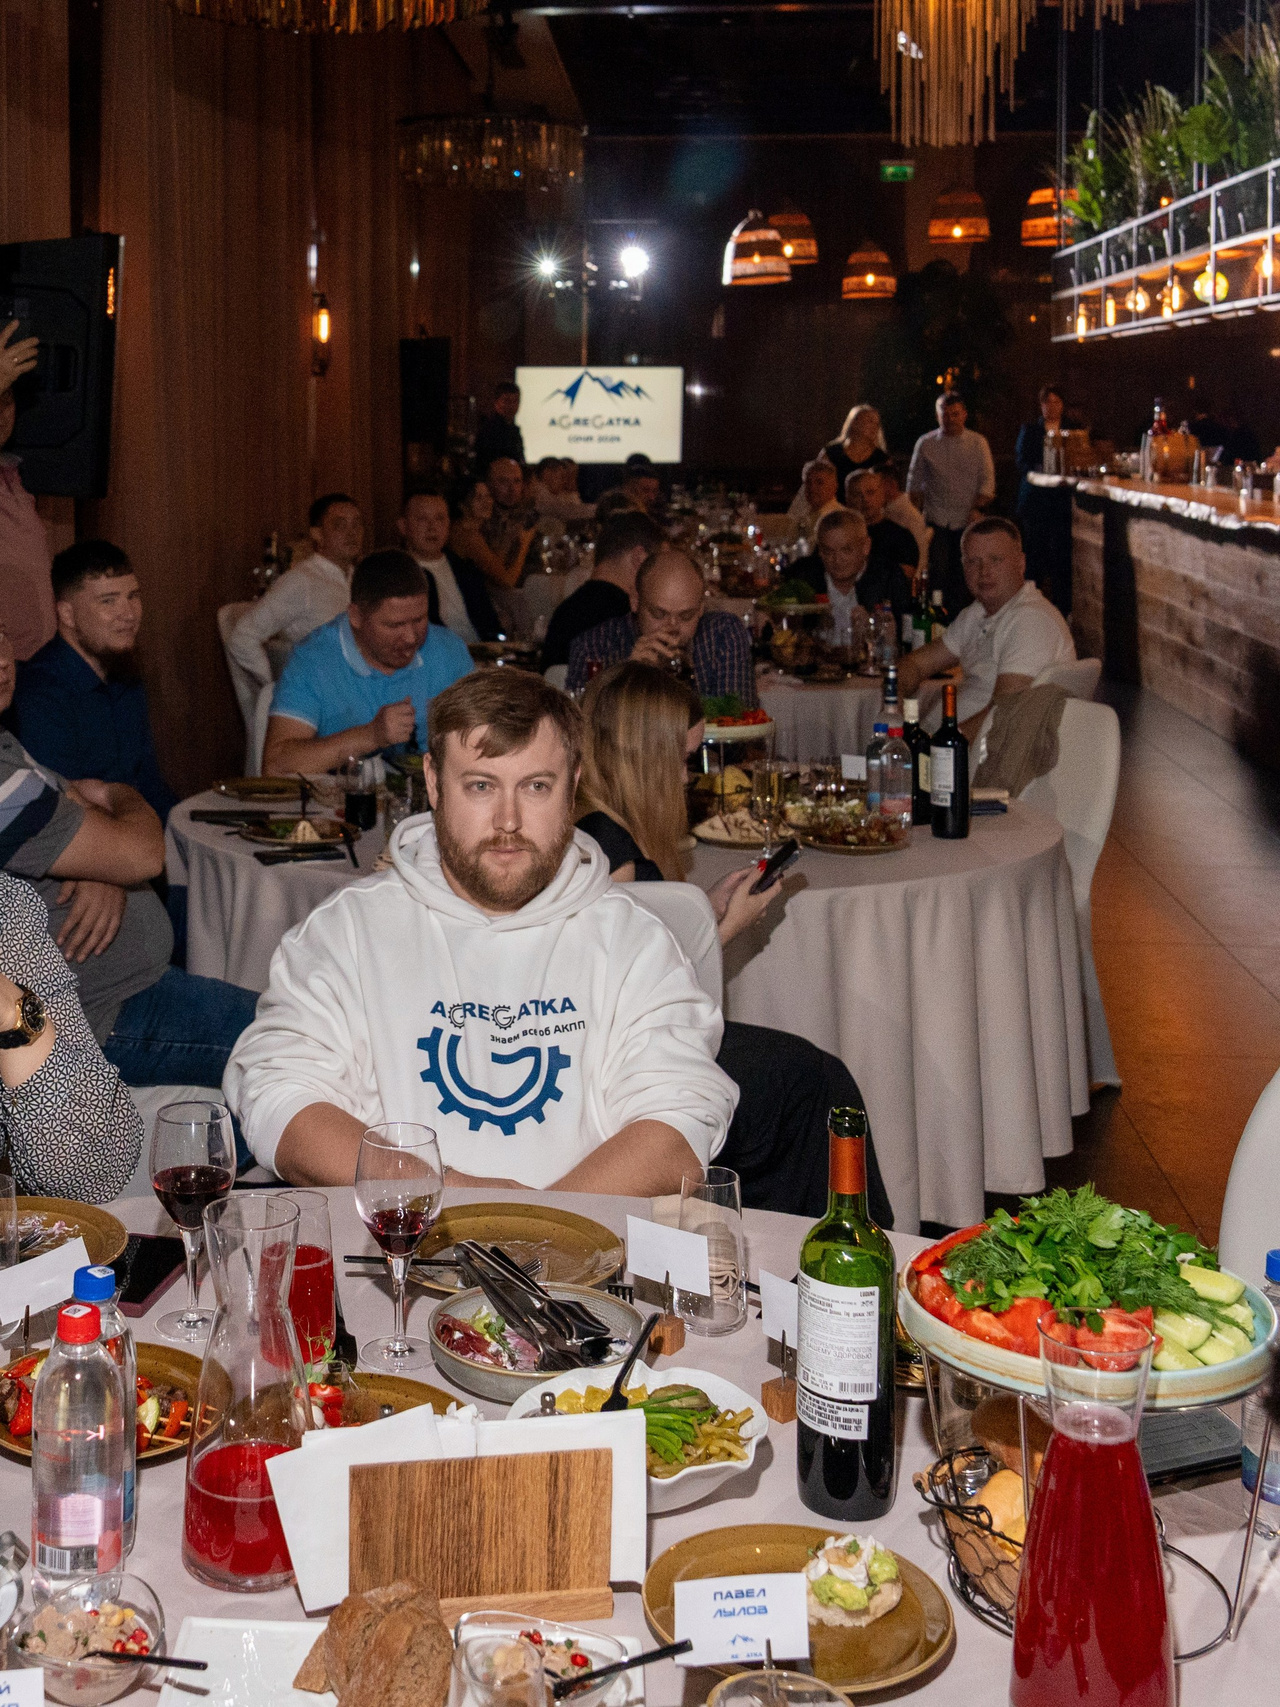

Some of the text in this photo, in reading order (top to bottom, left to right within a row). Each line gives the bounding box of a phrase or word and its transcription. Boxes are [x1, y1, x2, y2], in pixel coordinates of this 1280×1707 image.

[549, 414, 641, 430] AGREGATKA
[430, 997, 577, 1030] AGREGATKA
[490, 1033, 520, 1044] знаем
[539, 1027, 550, 1037] об
[553, 1020, 586, 1034] АКПП
[713, 1588, 766, 1601] ПАВЕЛ
[713, 1605, 768, 1619] ЛЫЛОВ
